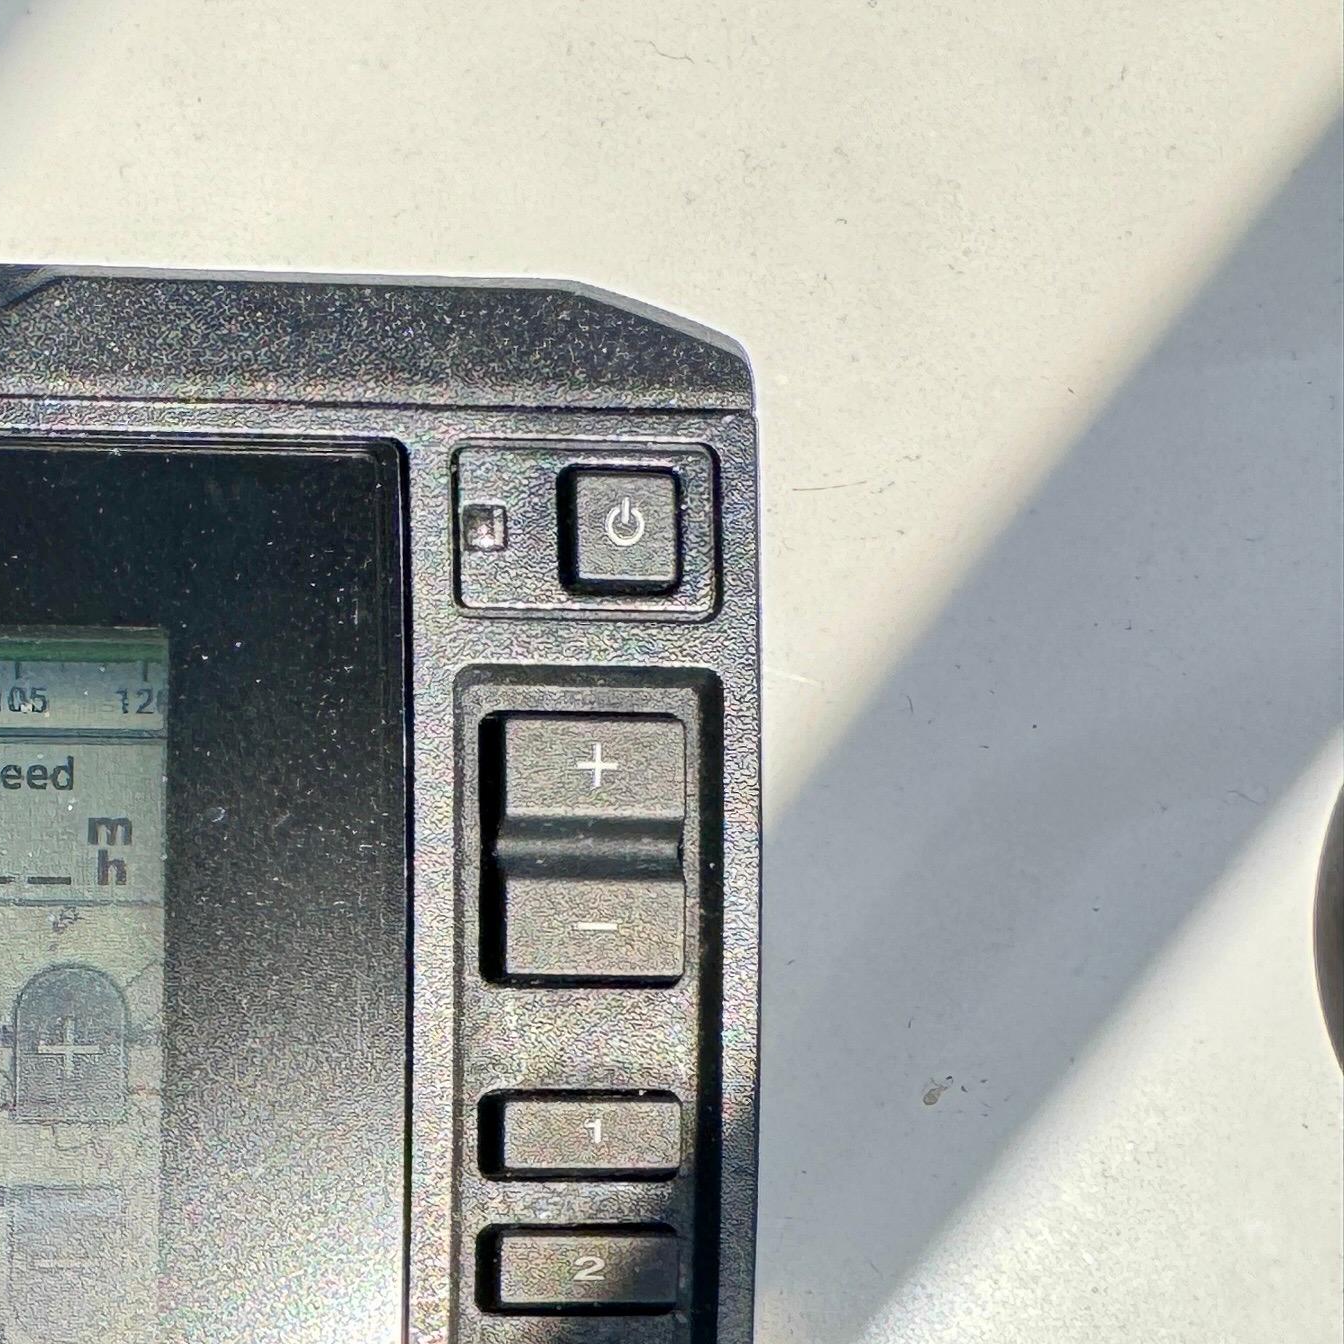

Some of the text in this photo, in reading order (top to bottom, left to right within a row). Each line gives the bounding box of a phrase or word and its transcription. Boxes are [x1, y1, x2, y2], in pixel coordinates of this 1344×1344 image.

[88, 817, 133, 847] m
[97, 850, 128, 886] h
[584, 1117, 604, 1145] 1
[571, 1255, 607, 1283] 2
